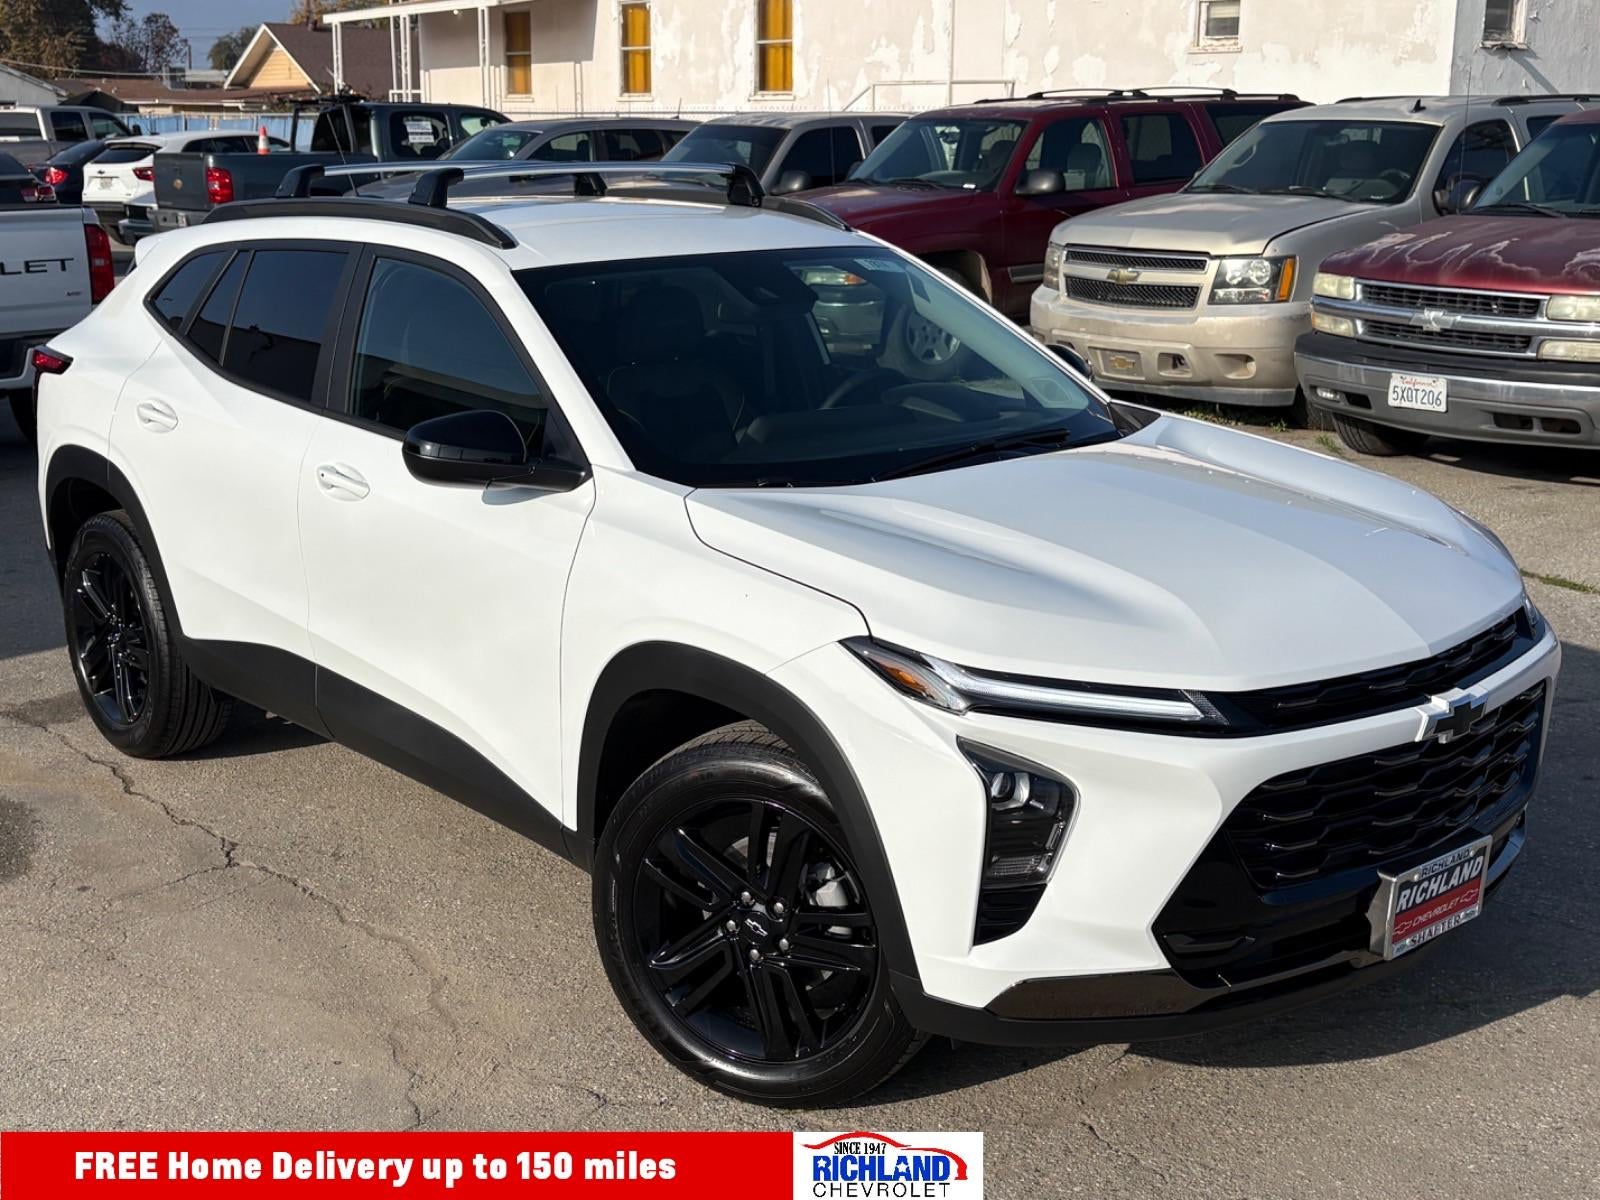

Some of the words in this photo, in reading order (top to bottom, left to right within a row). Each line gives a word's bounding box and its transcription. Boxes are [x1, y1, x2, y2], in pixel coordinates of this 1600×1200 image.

[1421, 850, 1471, 878] RICHLAND
[1397, 855, 1484, 913] RICHLAND
[1412, 897, 1459, 927] CHEVROLET
